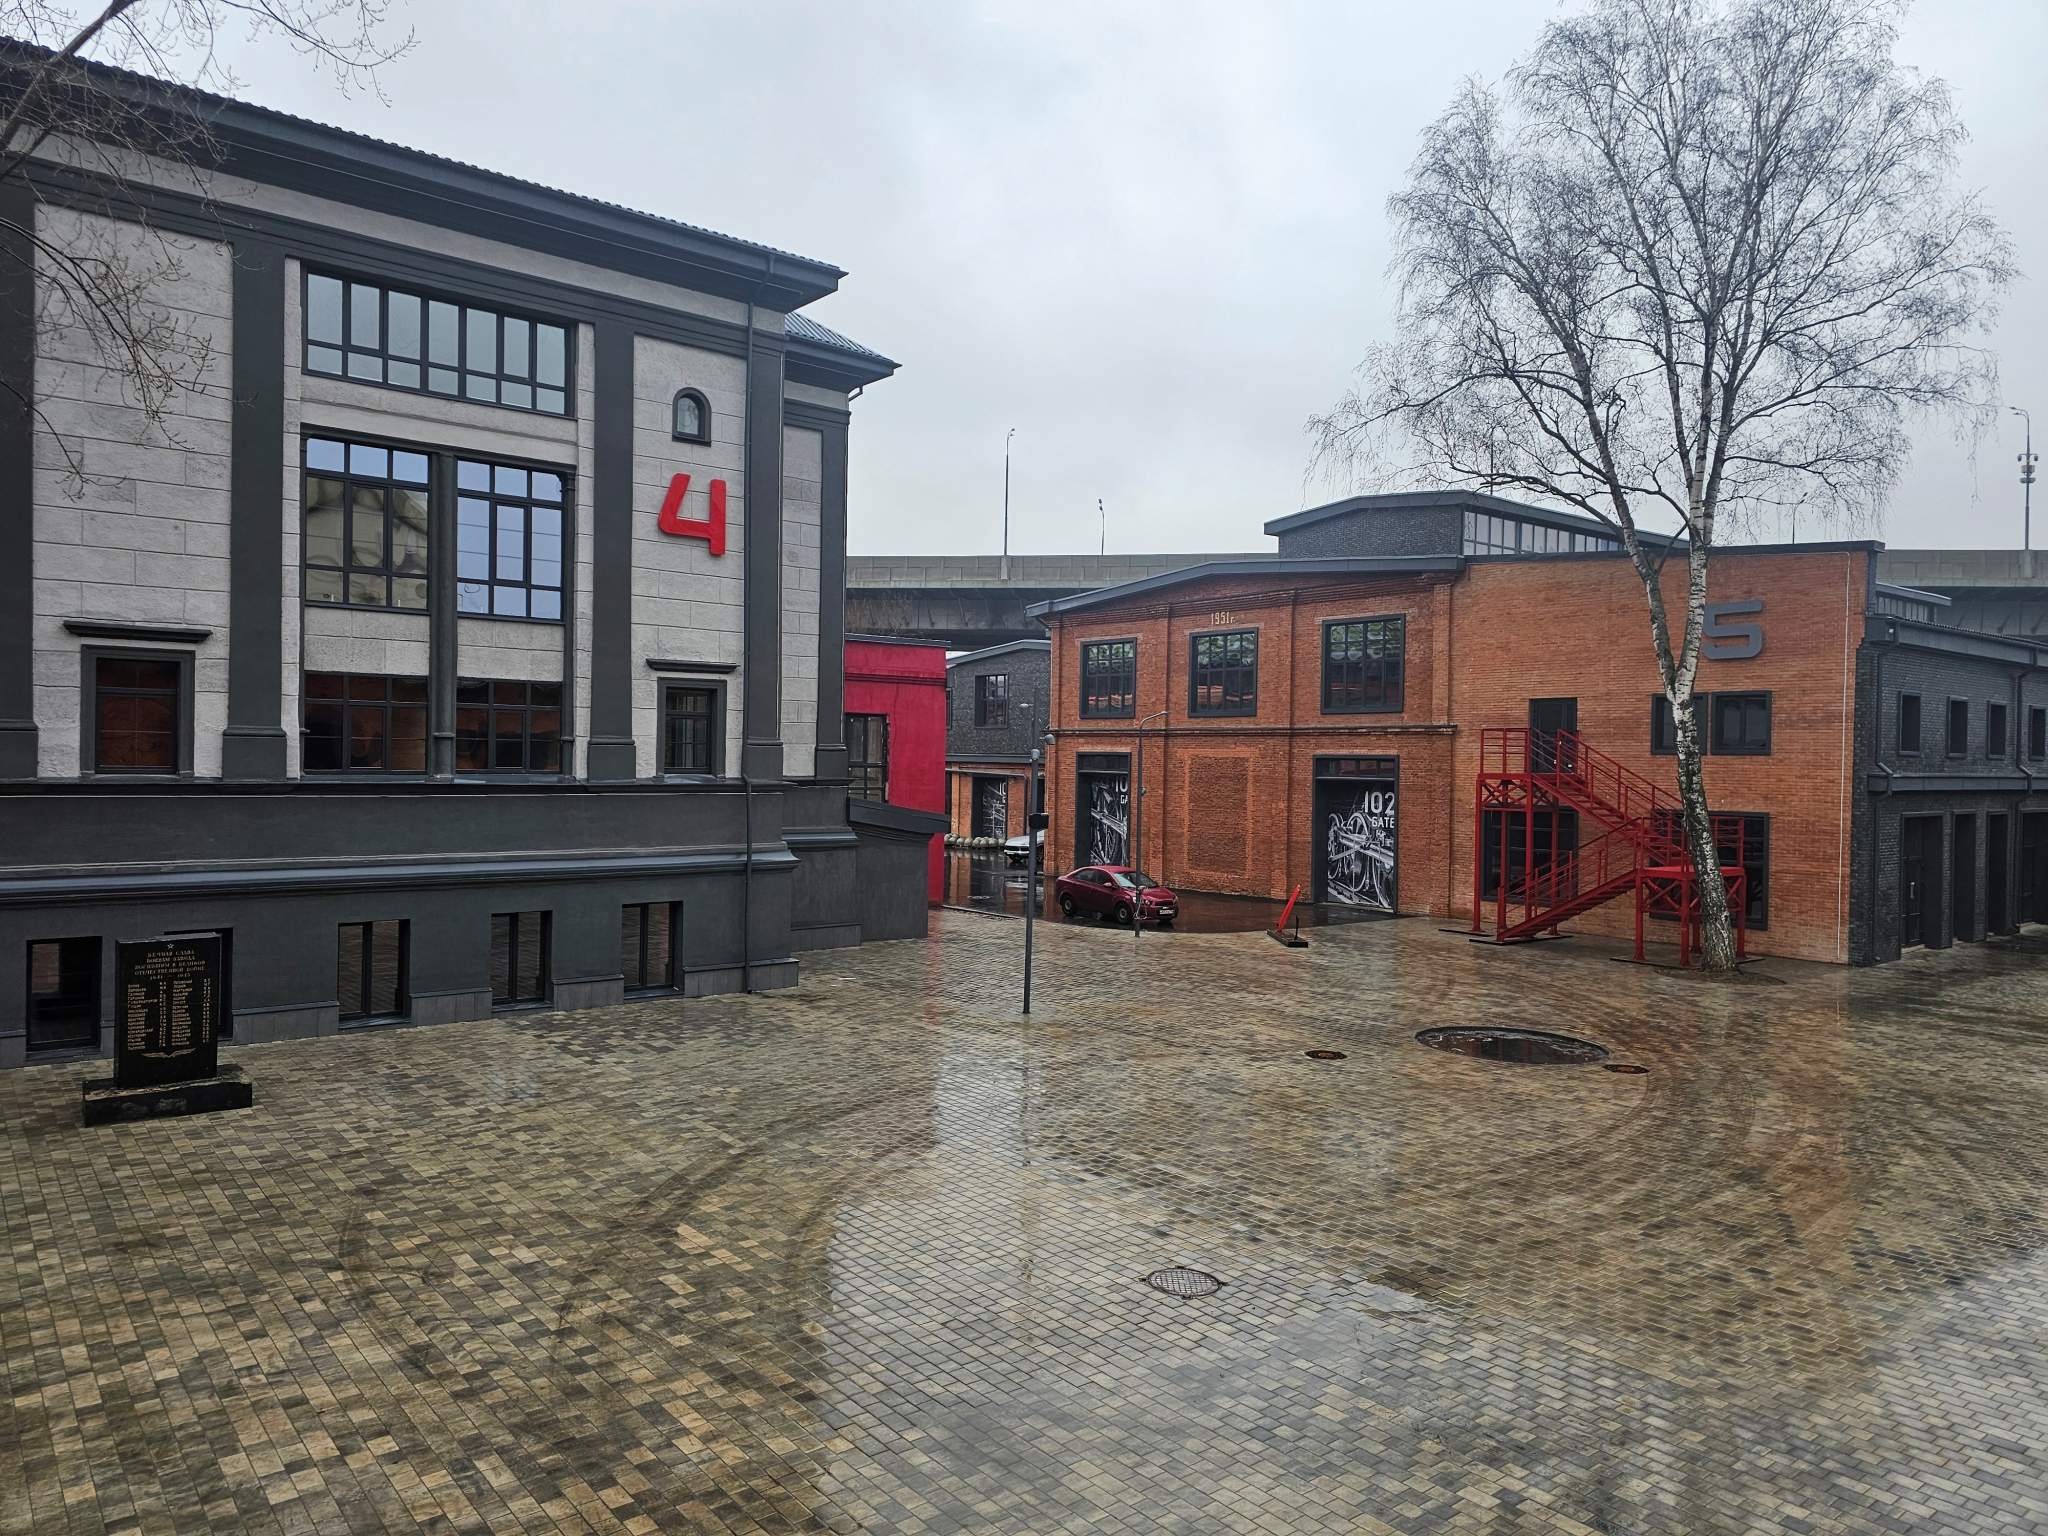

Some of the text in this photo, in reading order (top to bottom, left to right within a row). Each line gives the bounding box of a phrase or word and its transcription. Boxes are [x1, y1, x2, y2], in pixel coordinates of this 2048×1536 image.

[1703, 600, 1763, 660] 5
[1364, 790, 1395, 817] 102
[1371, 816, 1395, 829] GATE
